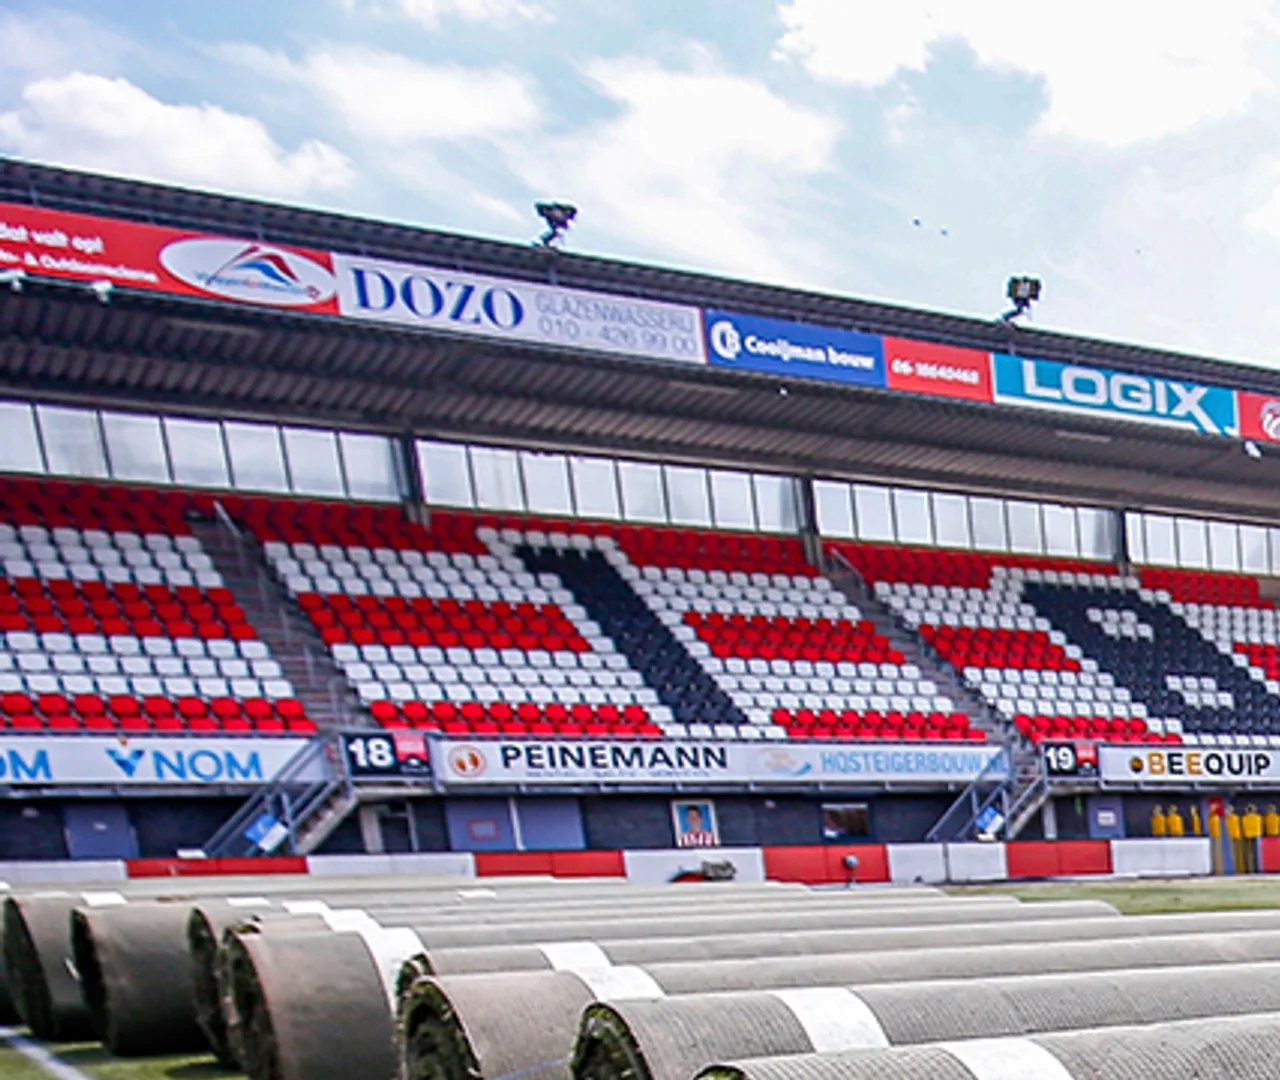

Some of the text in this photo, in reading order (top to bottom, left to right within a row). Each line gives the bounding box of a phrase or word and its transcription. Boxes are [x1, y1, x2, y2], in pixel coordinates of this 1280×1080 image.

[351, 267, 525, 330] DOZO
[538, 315, 581, 340] 010
[672, 334, 698, 354] 00
[828, 346, 875, 371] bouw
[1021, 359, 1220, 436] LOGIX
[348, 739, 395, 768] 18
[501, 746, 728, 770] PEINEMANN
[1046, 746, 1074, 770] 19
[1147, 753, 1271, 776] BEEQUIP
